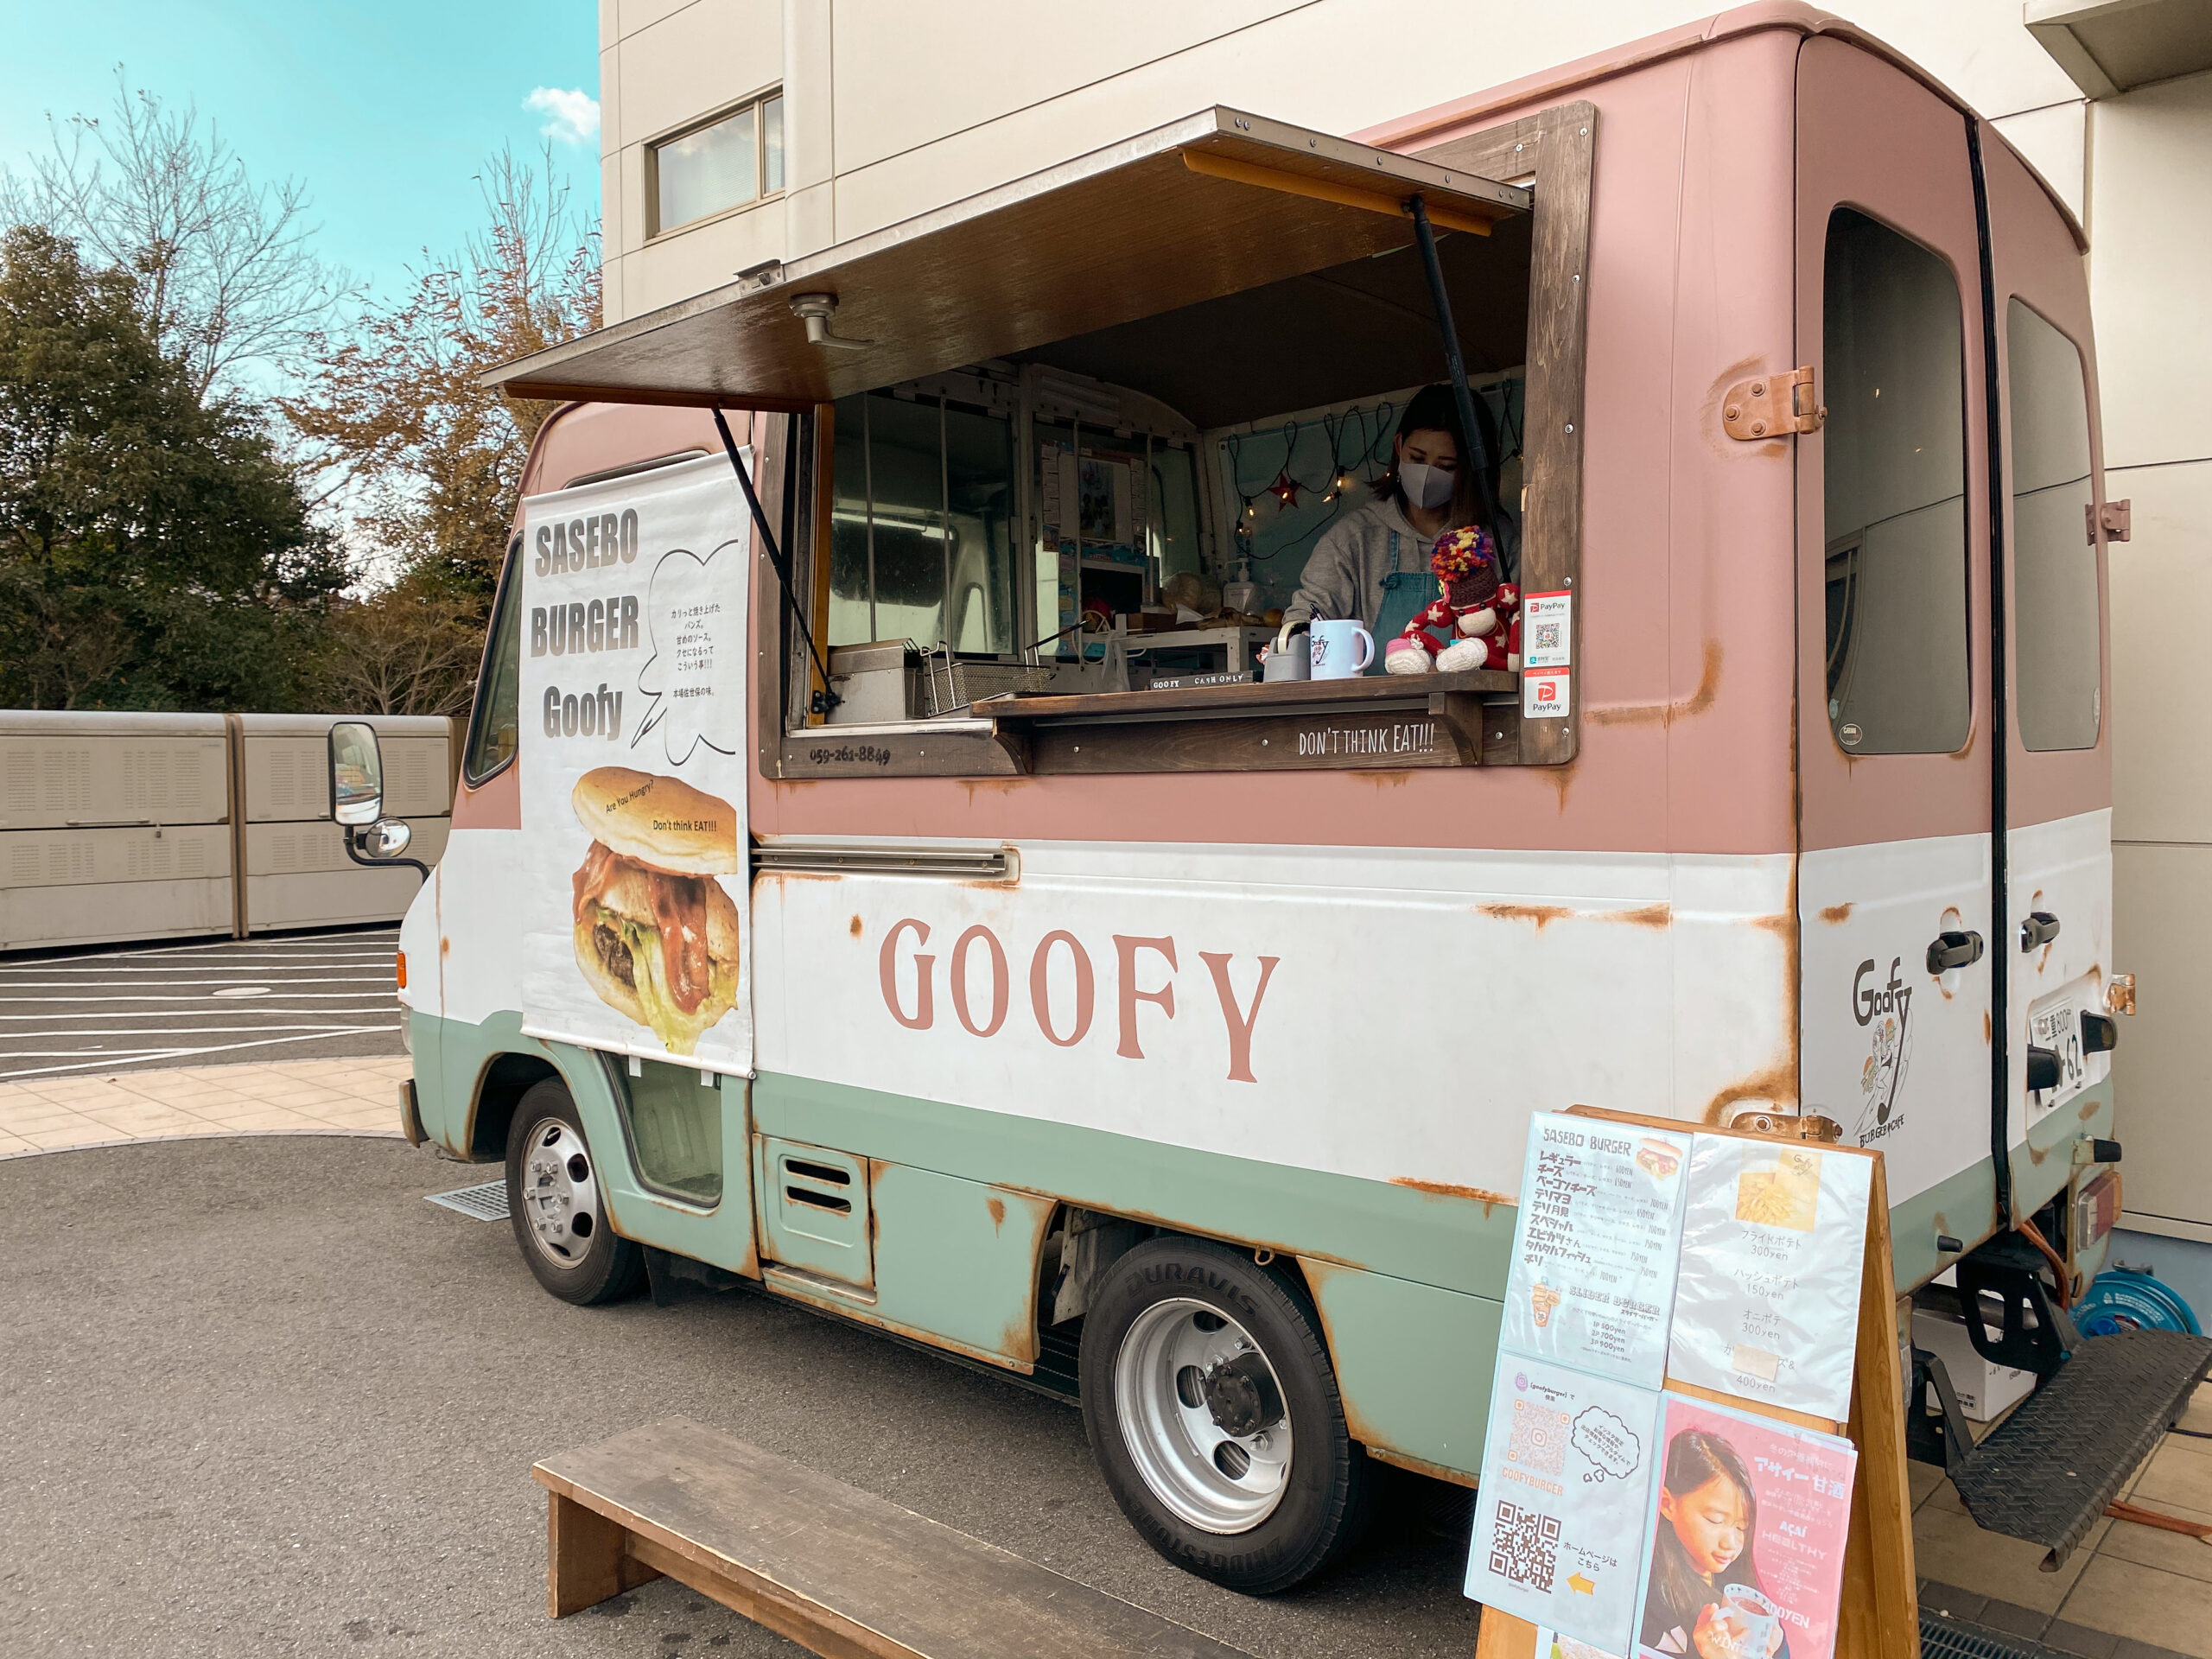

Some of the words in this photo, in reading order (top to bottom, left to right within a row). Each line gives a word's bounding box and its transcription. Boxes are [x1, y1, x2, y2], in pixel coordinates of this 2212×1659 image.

[535, 508, 639, 577] SASEBO
[671, 603, 721, 619] カリっと焼き上げた
[1541, 602, 1565, 611] PayPay
[531, 595, 639, 658] BURGER
[677, 645, 714, 658] クセになるって
[1154, 680, 1179, 689] GOOFY
[1194, 676, 1217, 684] CASH
[1219, 674, 1244, 683] ONLY
[543, 683, 622, 741] Goofy
[1533, 702, 1561, 712] PayPay
[1299, 727, 1339, 756] DON'T
[1343, 728, 1388, 754] THINK
[1393, 723, 1435, 753] EAT!!!
[810, 746, 891, 766] 059-261-8849
[606, 804, 616, 814] Are
[617, 796, 629, 806] You
[629, 779, 654, 802] Hungry?
[653, 820, 672, 831] Don't
[673, 820, 692, 831] think
[694, 821, 716, 832] EAT!!!
[879, 918, 1281, 1084] GOOFY
[1543, 1128, 1585, 1147] SASEBO
[1590, 1136, 1631, 1156] BURGER
[1540, 1150, 1581, 1166] レギュラー
[1537, 1164, 1564, 1177] チーズ
[1535, 1176, 1598, 1197] ベーコンチーズ
[1535, 1188, 1572, 1205] テリマヨ
[1532, 1201, 1569, 1217] テリ月見
[1530, 1213, 1574, 1232] スペシャル
[1527, 1227, 1581, 1249] エビカツさん
[1741, 1230, 1802, 1249] フライドポテト
[1524, 1254, 1542, 1267] チリ
[1751, 1245, 1789, 1262] 300yen
[1734, 1268, 1799, 1289] ハッシュポテト
[1125, 1262, 1261, 1318] DURAVIS
[1746, 1283, 1783, 1300] 150yen
[1569, 1285, 1610, 1303] SLIDER
[1613, 1296, 1660, 1315] BURGER
[1743, 1308, 1782, 1325] オニポテ
[1601, 1323, 1626, 1335] 500yen
[1742, 1323, 1780, 1340] 300yen
[1599, 1339, 1625, 1353] 900yen
[1600, 1332, 1625, 1344] 700yen
[1737, 1375, 1776, 1393] 400yen
[1502, 1466, 1563, 1497] GOOFYBURGER
[1563, 1541, 1618, 1567] ホームページは
[1577, 1557, 1600, 1572] こちら
